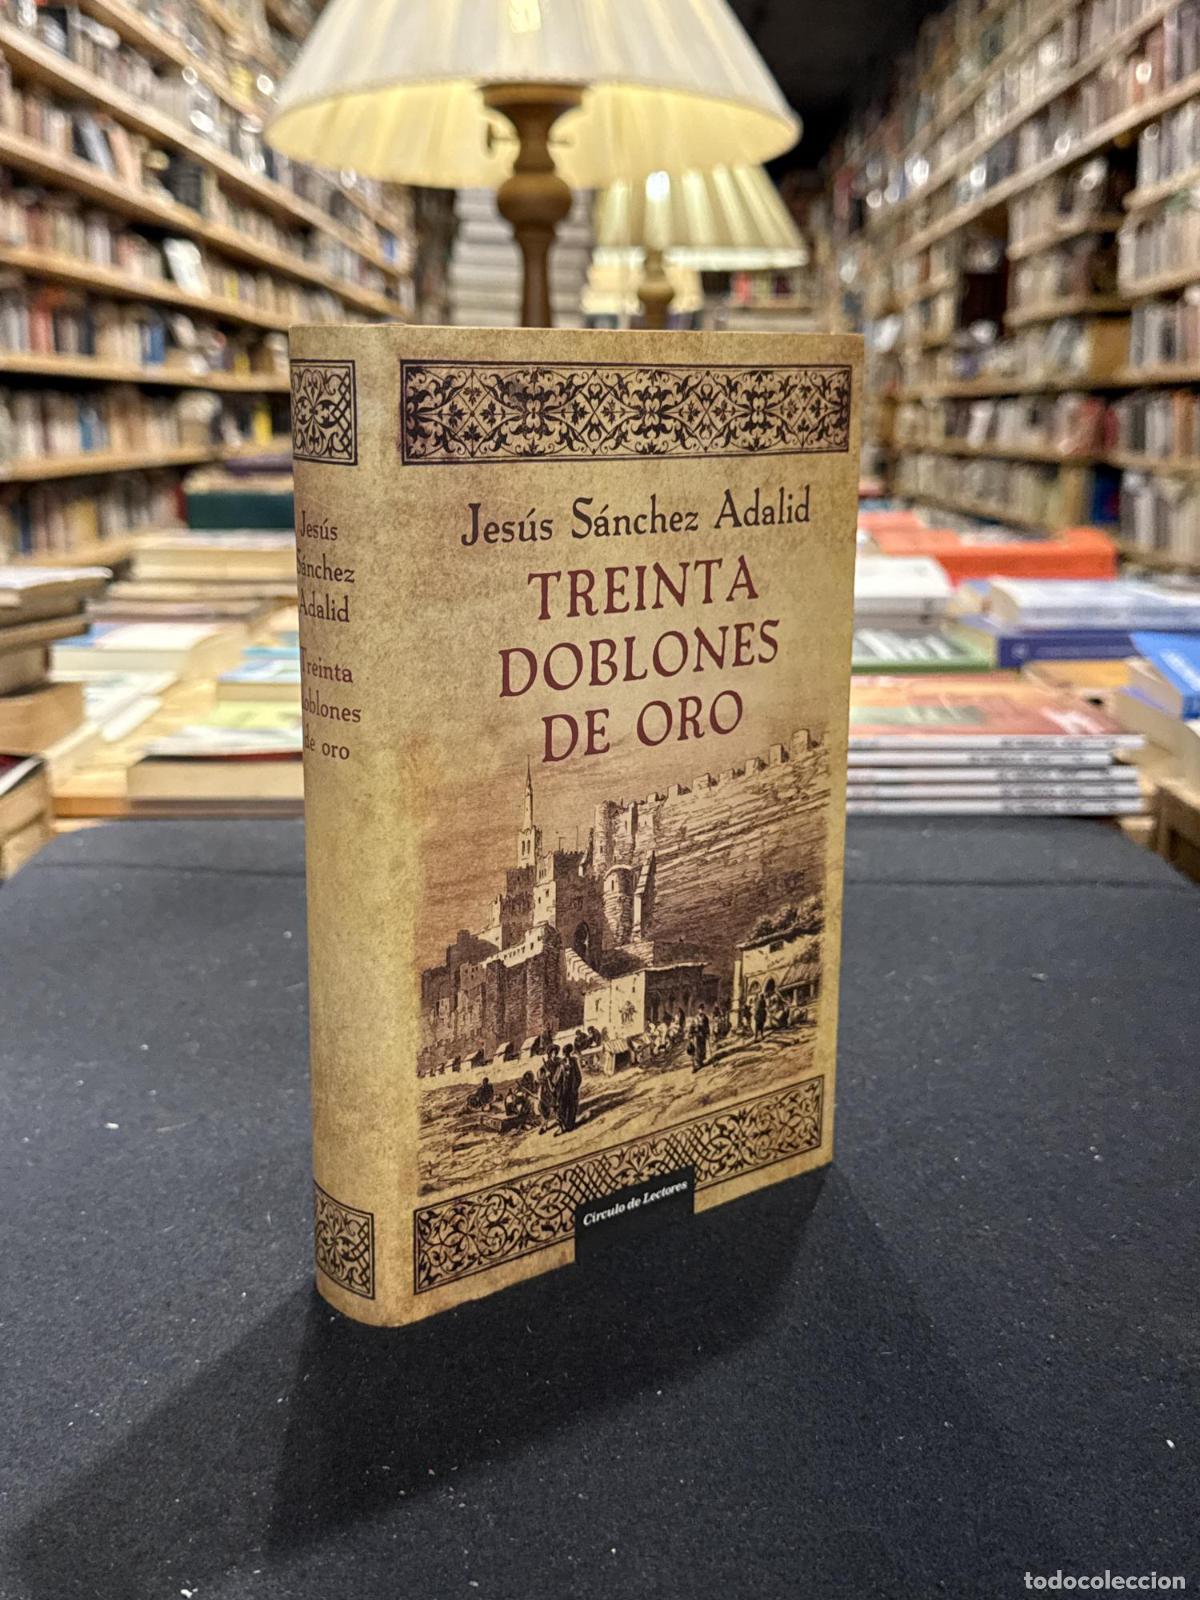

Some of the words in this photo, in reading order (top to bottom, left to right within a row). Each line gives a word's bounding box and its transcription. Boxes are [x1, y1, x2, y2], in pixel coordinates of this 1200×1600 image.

[300, 510, 339, 541] Jesús
[461, 502, 554, 546] Jesús
[571, 493, 700, 540] Sánchez
[714, 484, 811, 530] Adalid
[299, 587, 350, 623] Adalid
[527, 554, 760, 621] TREINTA
[498, 619, 781, 698] DOBLONES
[302, 687, 362, 723] oblones
[541, 708, 611, 763] DE
[636, 690, 744, 746] ORO
[321, 742, 350, 760] oro
[626, 1197, 642, 1210] de
[642, 1180, 689, 1205] Lectores
